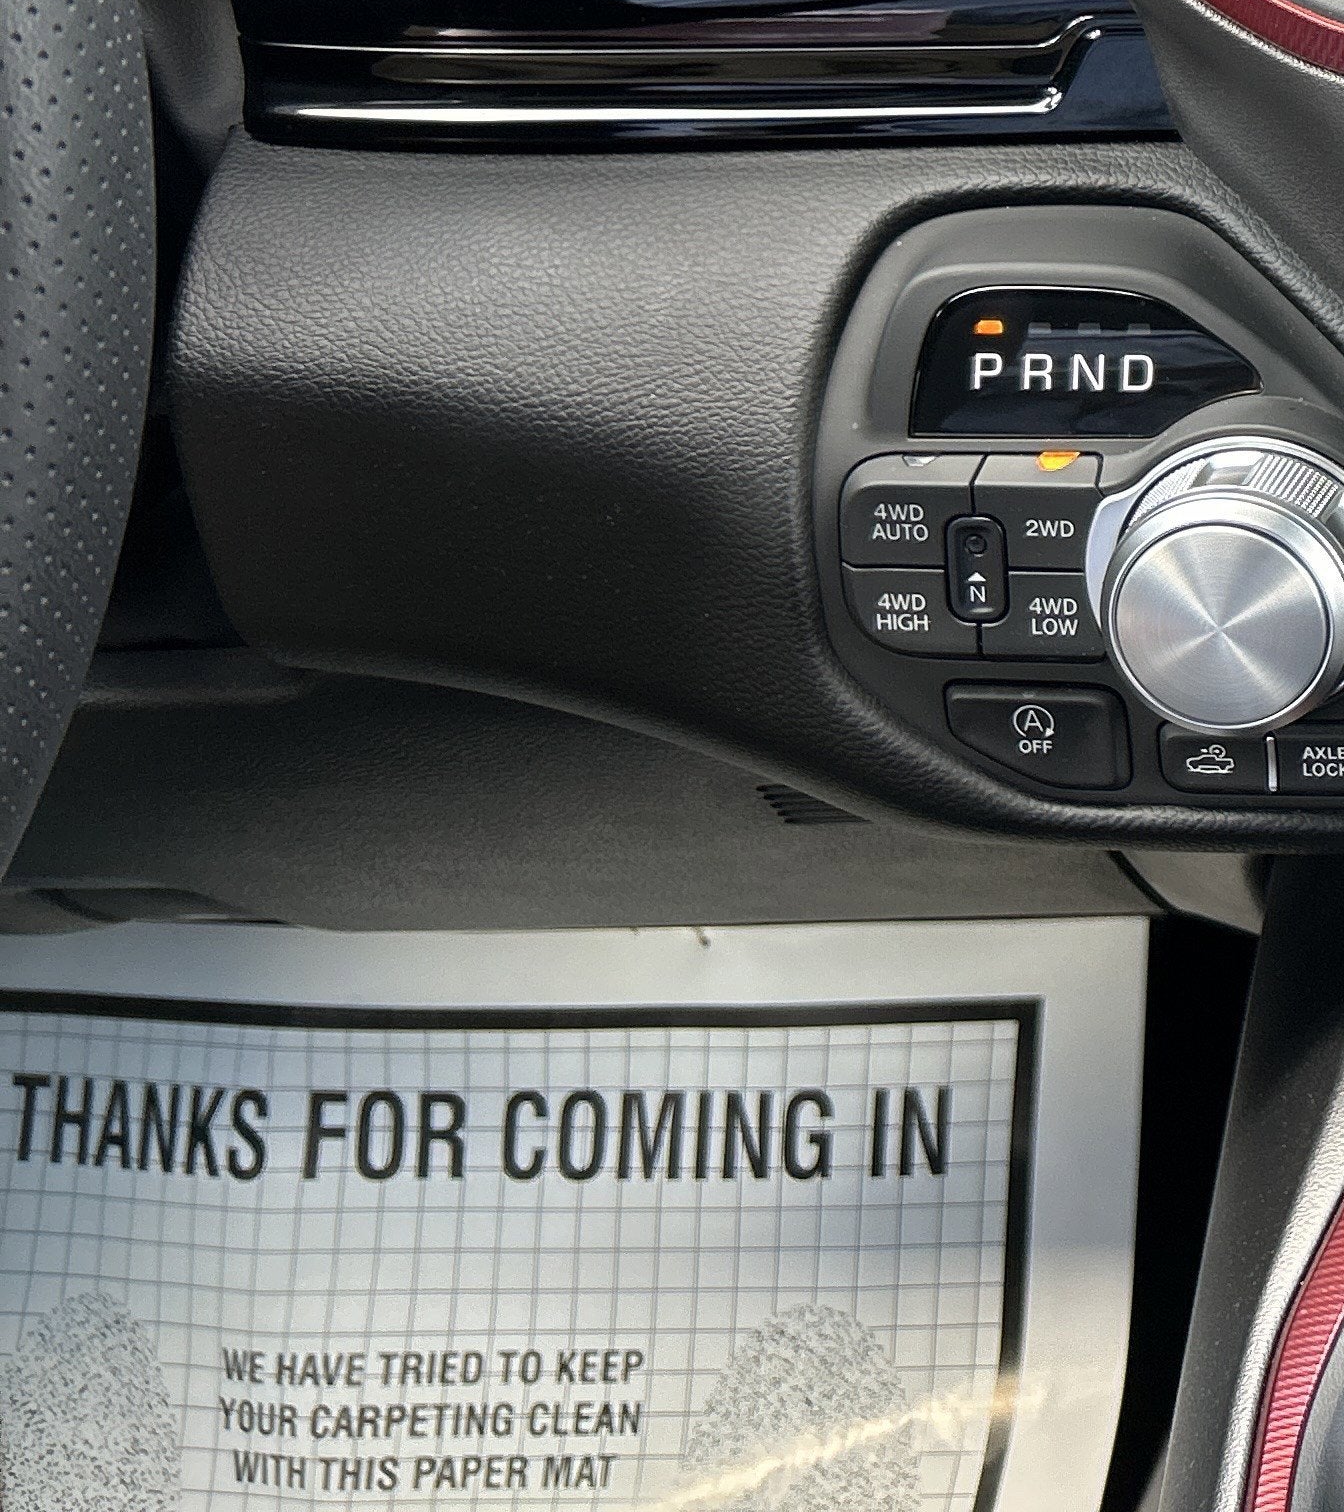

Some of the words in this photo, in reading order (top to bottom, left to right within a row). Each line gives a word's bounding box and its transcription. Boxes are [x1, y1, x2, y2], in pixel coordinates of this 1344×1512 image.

[872, 502, 926, 524] 4WD
[871, 523, 929, 542] AUTO
[1025, 519, 1075, 538] 2WD
[876, 592, 926, 612] 4WD
[1029, 598, 1078, 617] 4WD
[876, 613, 930, 633] HIGH
[1031, 618, 1079, 637] LOW
[1018, 739, 1053, 754] OFF
[14, 1074, 268, 1180] THANKS
[302, 1090, 466, 1180] FOR
[503, 1088, 834, 1180] COMING
[870, 1085, 952, 1178] IN
[220, 1348, 265, 1383] WE
[275, 1350, 366, 1386] HAVE
[378, 1350, 484, 1385] TRIED
[499, 1351, 542, 1384] TO
[555, 1349, 645, 1383] KEEP
[217, 1396, 298, 1438] YOUR
[309, 1401, 514, 1440] CARPETING
[527, 1402, 643, 1437] CLEAN
[232, 1449, 306, 1488] WITH
[318, 1453, 400, 1491] THIS
[412, 1455, 529, 1489] PAPER
[539, 1455, 619, 1488] MAT
